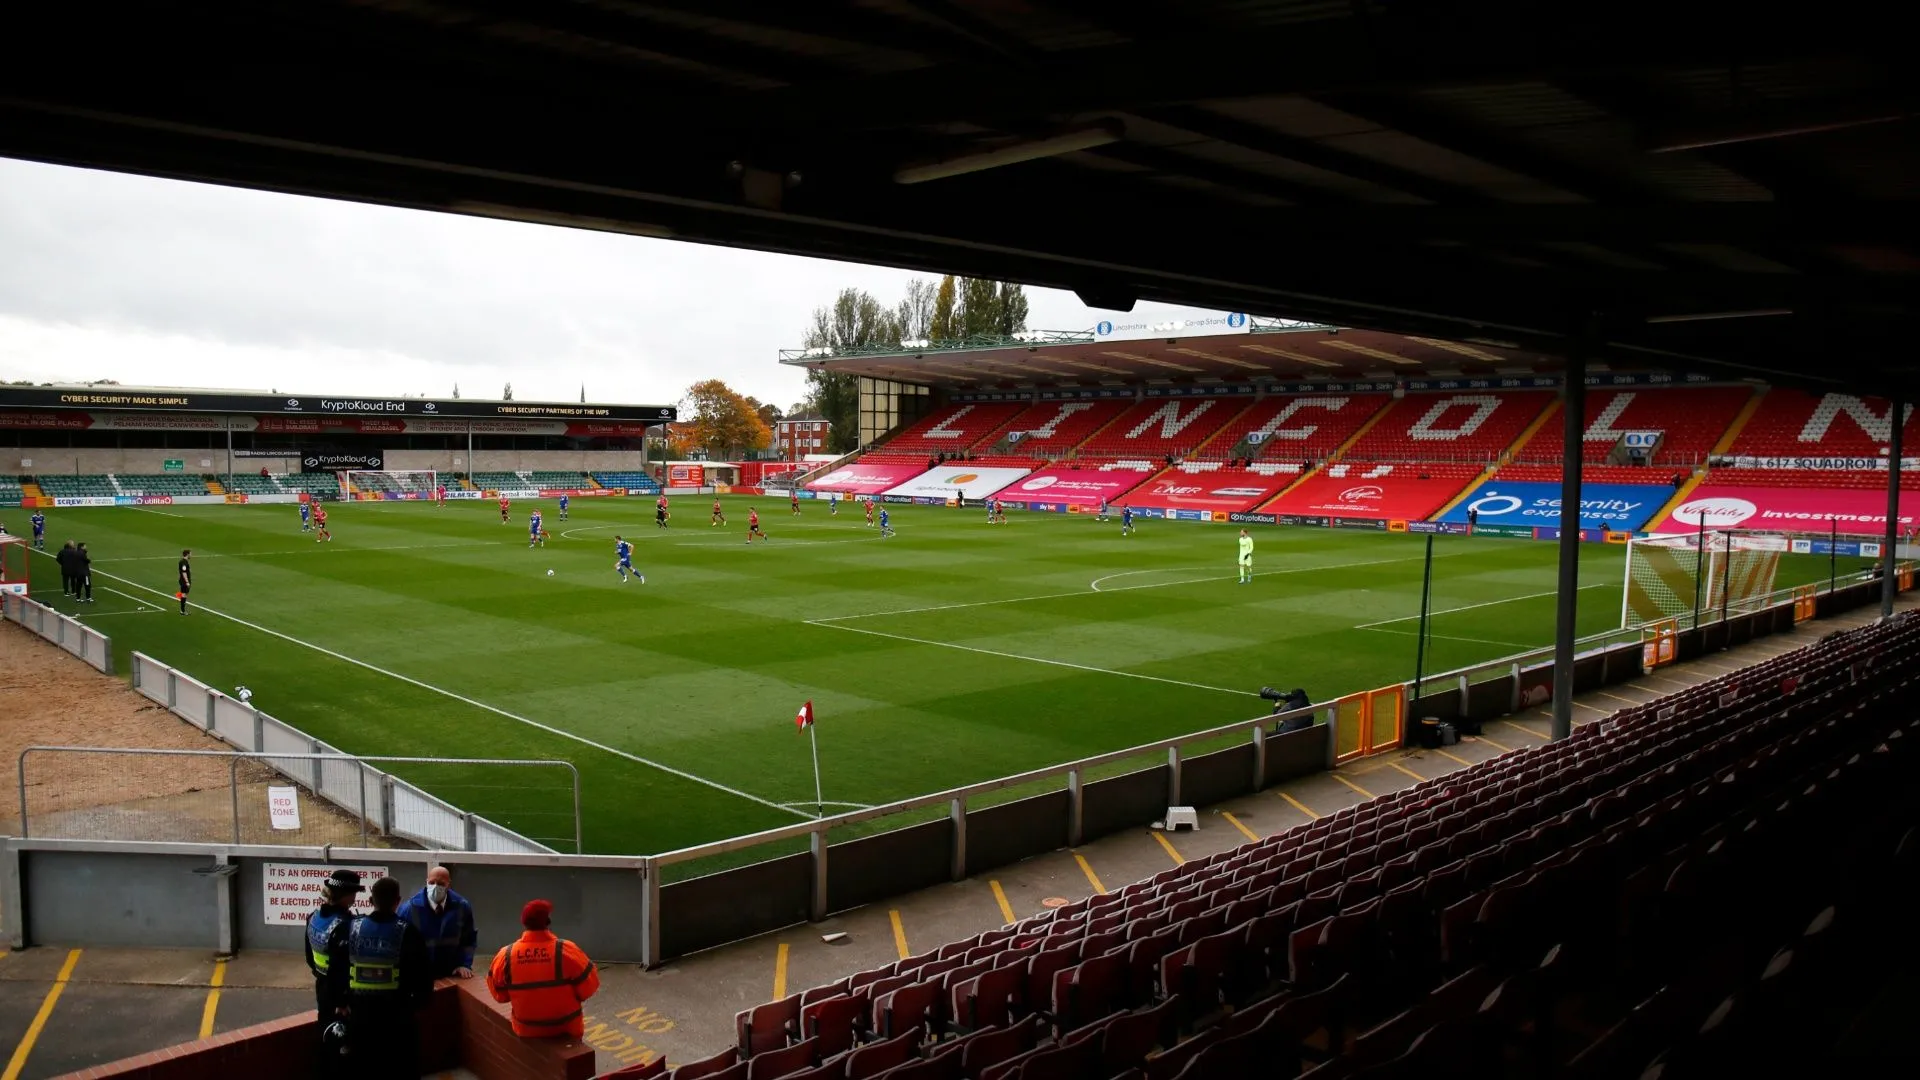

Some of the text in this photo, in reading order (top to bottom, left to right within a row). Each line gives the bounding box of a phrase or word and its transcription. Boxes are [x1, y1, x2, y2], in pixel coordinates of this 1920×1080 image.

[1206, 318, 1225, 326] Stand
[61, 395, 188, 405] CYBER SECURITY MADE SIMPLE
[321, 400, 405, 411] KryptoKloud End
[319, 455, 366, 464] KryptoKloud
[1766, 457, 1789, 469] 617
[1793, 457, 1877, 469] SQUADRON
[1533, 497, 1642, 511] seenity
[1239, 513, 1275, 523] KryptoKloud
[1522, 509, 1630, 520] expnses
[1761, 510, 1913, 523] Investmens
[272, 808, 295, 816] ZONE
[269, 868, 276, 876] IT
[288, 869, 299, 877] AN
[301, 869, 332, 878] OFFENCE
[370, 871, 384, 879] THE
[268, 883, 321, 892] PLAYING AREA
[270, 897, 279, 905] BE
[281, 898, 310, 906] EJECTED
[280, 912, 296, 920] AND
[615, 1006, 674, 1033] NO
